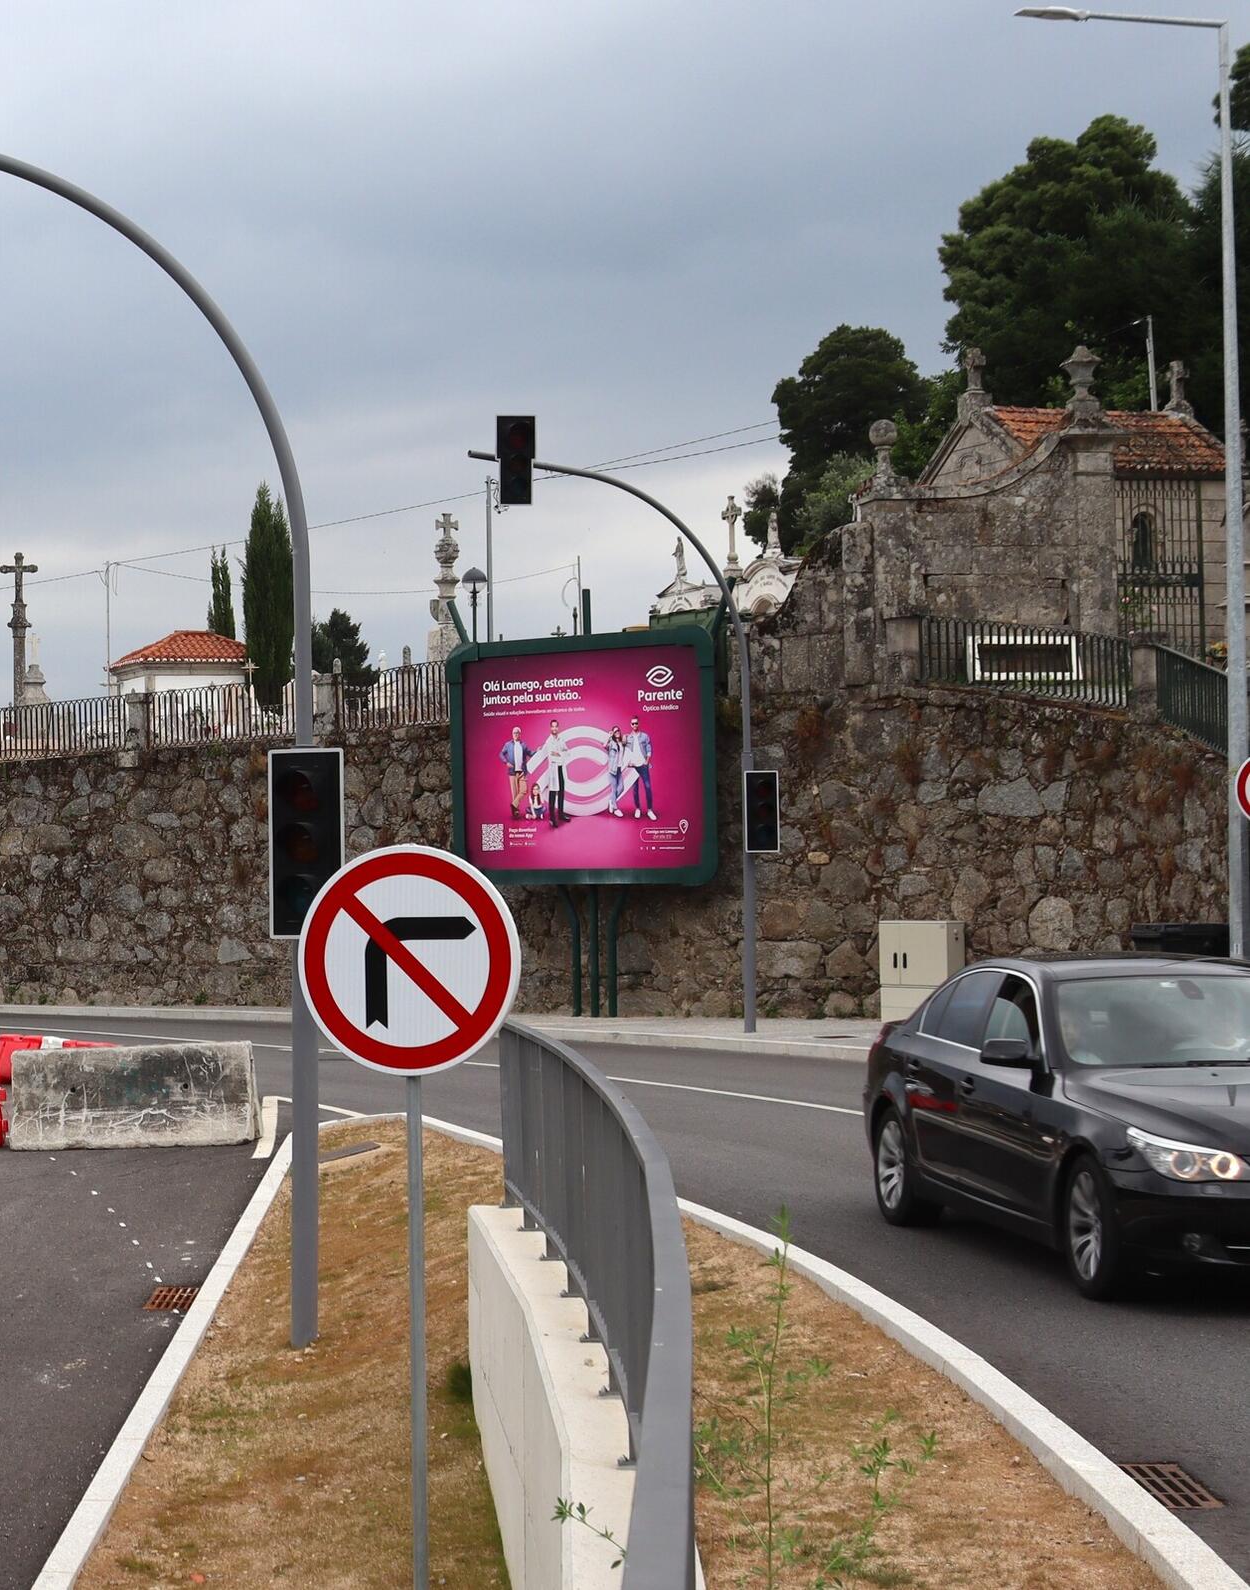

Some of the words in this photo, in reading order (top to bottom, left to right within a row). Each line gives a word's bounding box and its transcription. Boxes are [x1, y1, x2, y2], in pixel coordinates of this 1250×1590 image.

[483, 680, 500, 692] Olá
[502, 681, 542, 692] Lamego,
[544, 678, 584, 688] estamos
[482, 694, 511, 708] juntos
[512, 692, 533, 706] pela
[535, 693, 551, 702] sua
[553, 690, 581, 701] visão.
[637, 689, 683, 702] Parente
